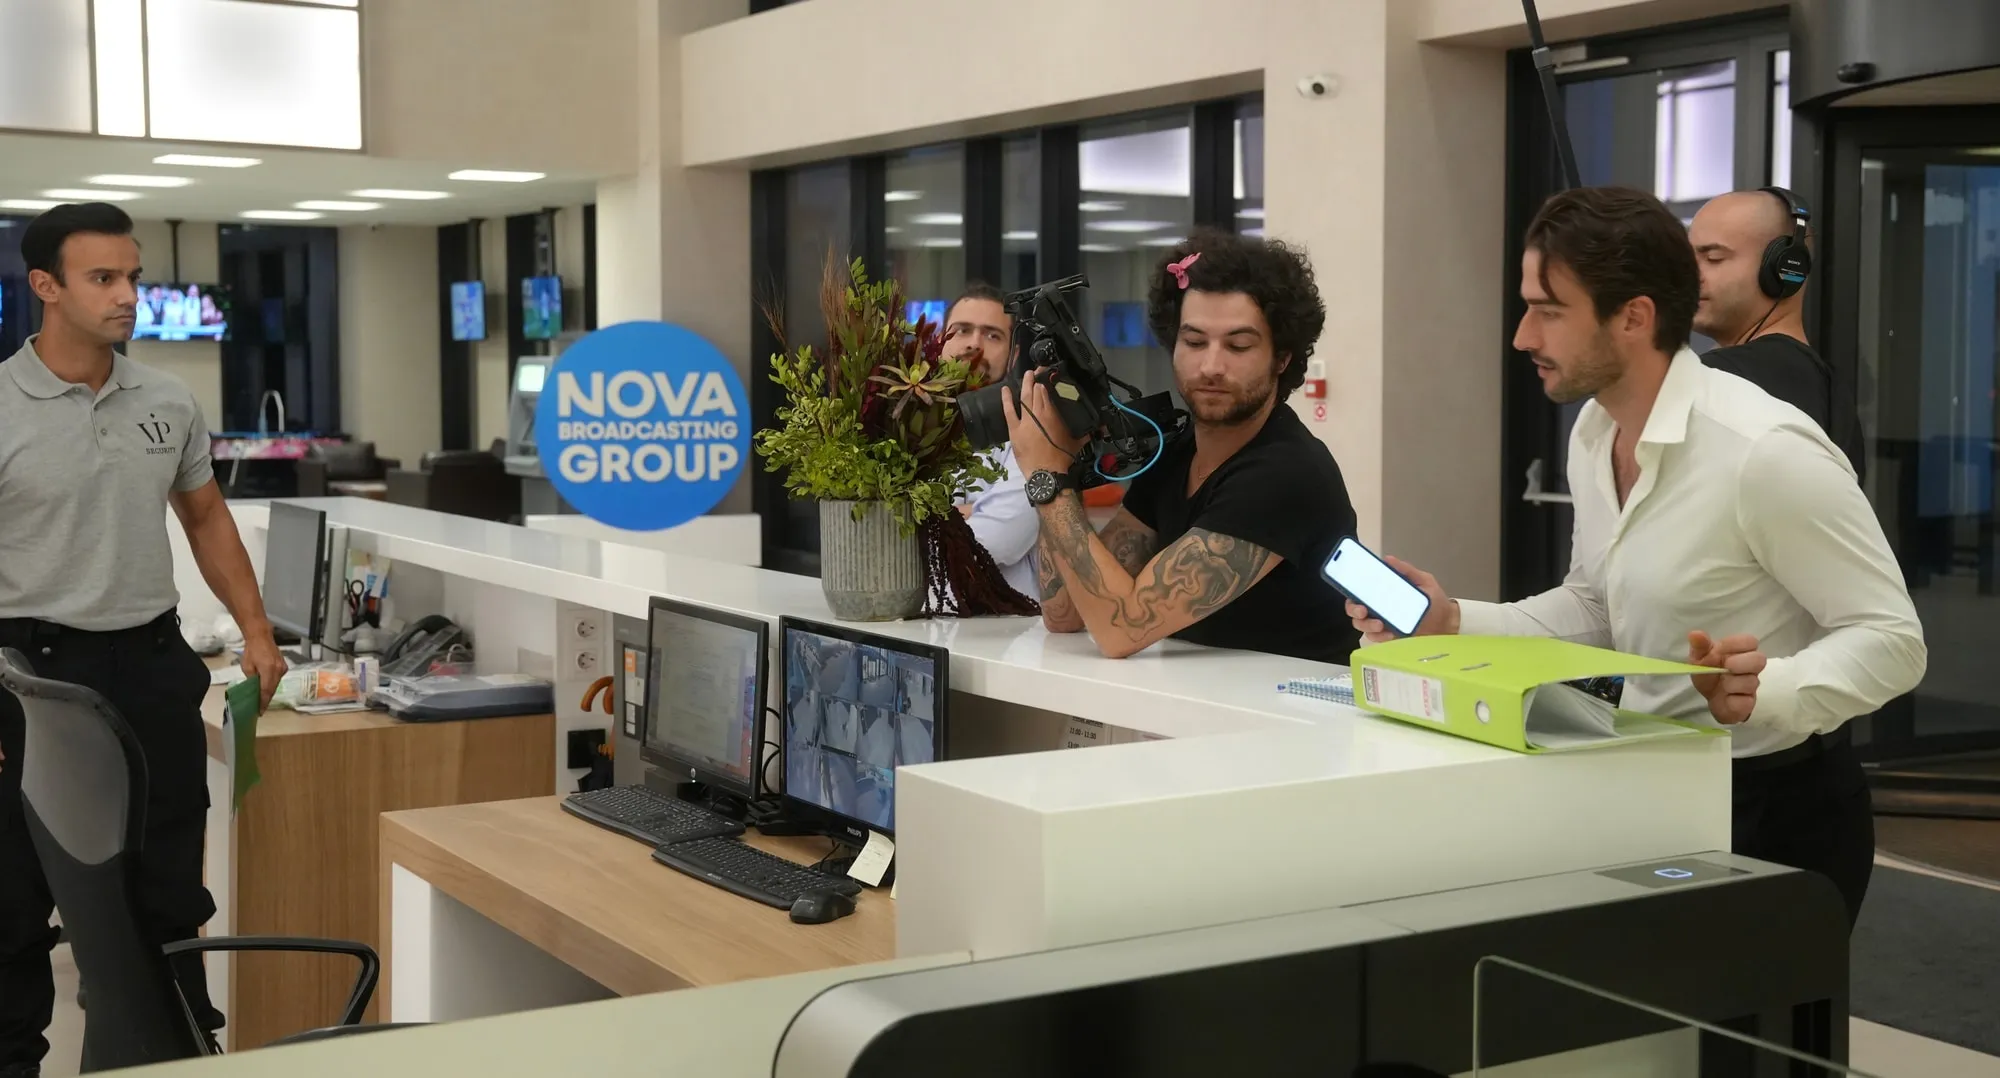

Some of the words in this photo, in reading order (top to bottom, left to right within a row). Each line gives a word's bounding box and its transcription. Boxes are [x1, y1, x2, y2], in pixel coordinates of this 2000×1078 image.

[557, 370, 737, 418] NOVA
[558, 421, 738, 440] BROADCASTING
[145, 446, 176, 455] SECURITY
[558, 443, 739, 483] GROUP
[846, 826, 862, 838] PHILIPS
